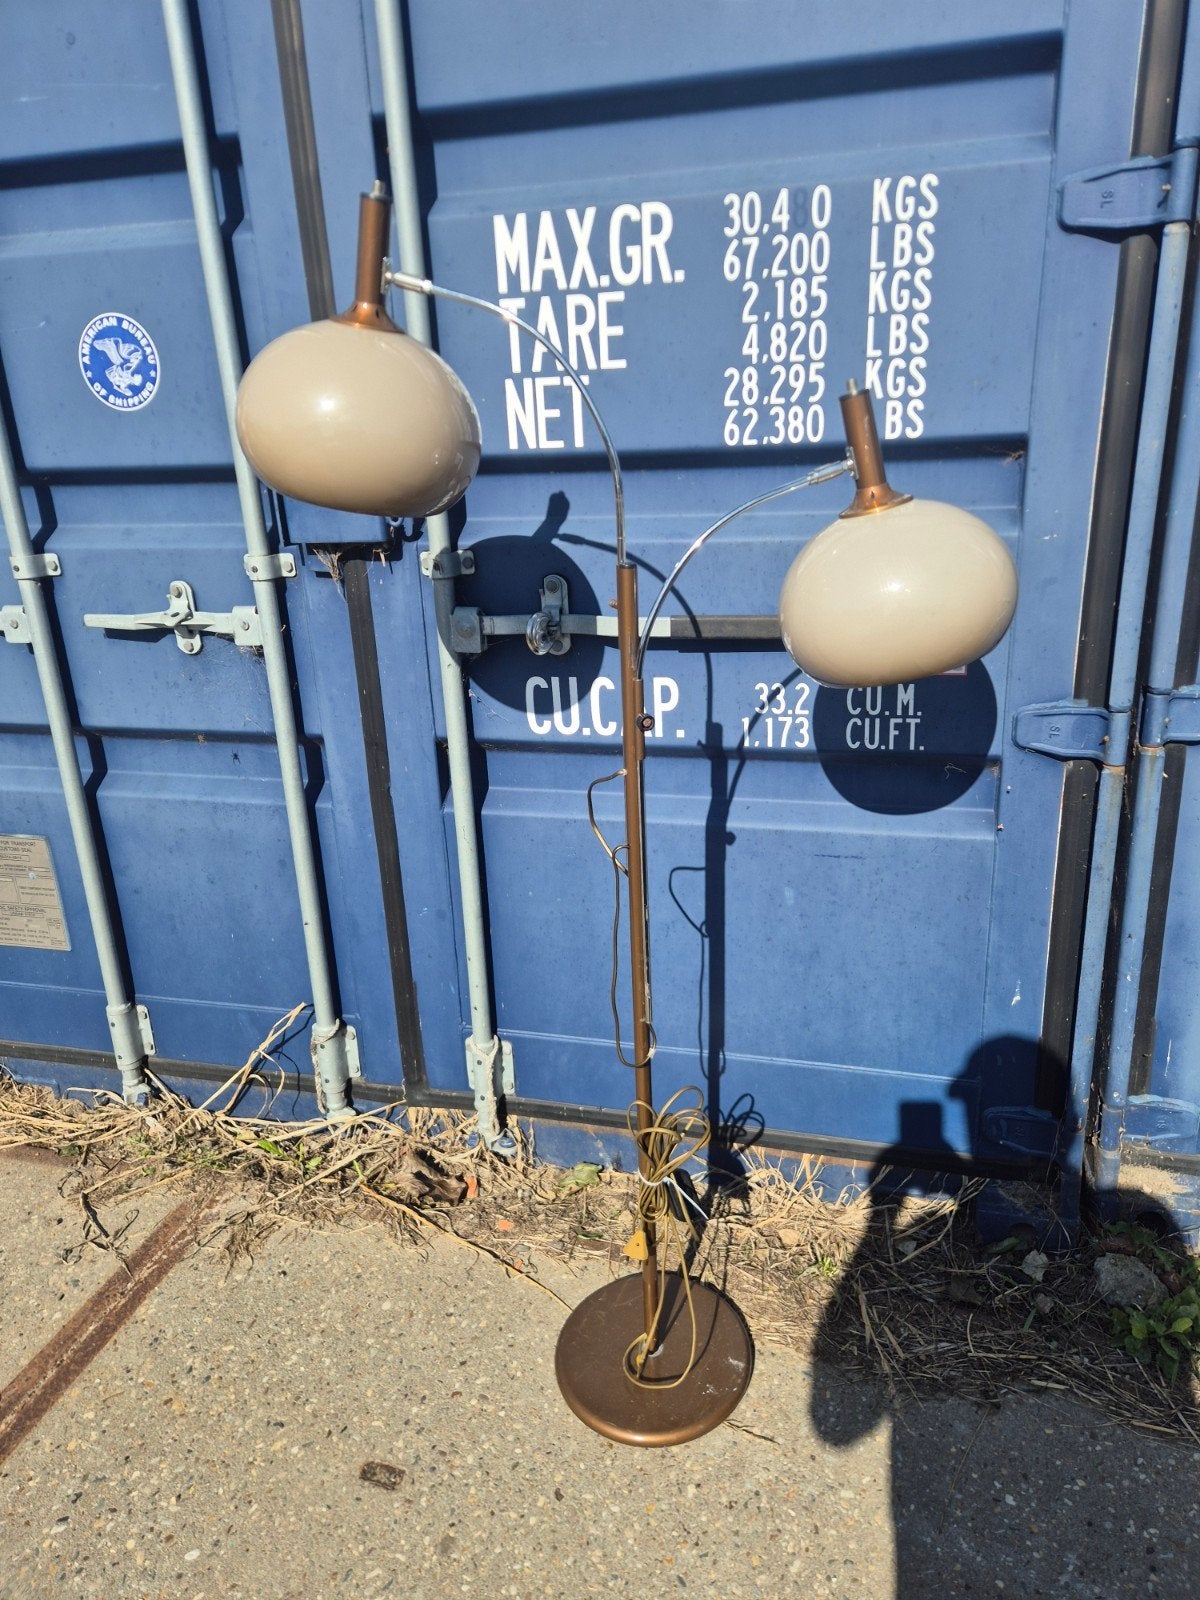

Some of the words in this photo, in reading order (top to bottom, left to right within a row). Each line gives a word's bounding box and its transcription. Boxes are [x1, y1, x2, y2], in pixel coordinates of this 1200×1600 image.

[492, 201, 686, 295] MAX.GR.
[871, 173, 939, 224] KGS
[723, 230, 831, 282] 67,200
[869, 220, 935, 271] LBS
[81, 316, 118, 364] AMERICAN
[121, 319, 157, 364] BUREAU
[498, 290, 628, 374] TARE
[741, 274, 828, 324] 2,185
[867, 266, 933, 315] KGS
[741, 319, 828, 365] 4,820
[866, 312, 930, 358] LBS
[93, 381, 108, 397] OF
[107, 381, 154, 407] SHIPPING
[504, 375, 589, 450] NET
[723, 361, 826, 407] 28,295
[864, 356, 927, 400] KGS
[723, 403, 825, 447] 62,380
[884, 398, 925, 440] BS
[754, 682, 810, 716] 33.2
[845, 717, 925, 751] CU.FT.
